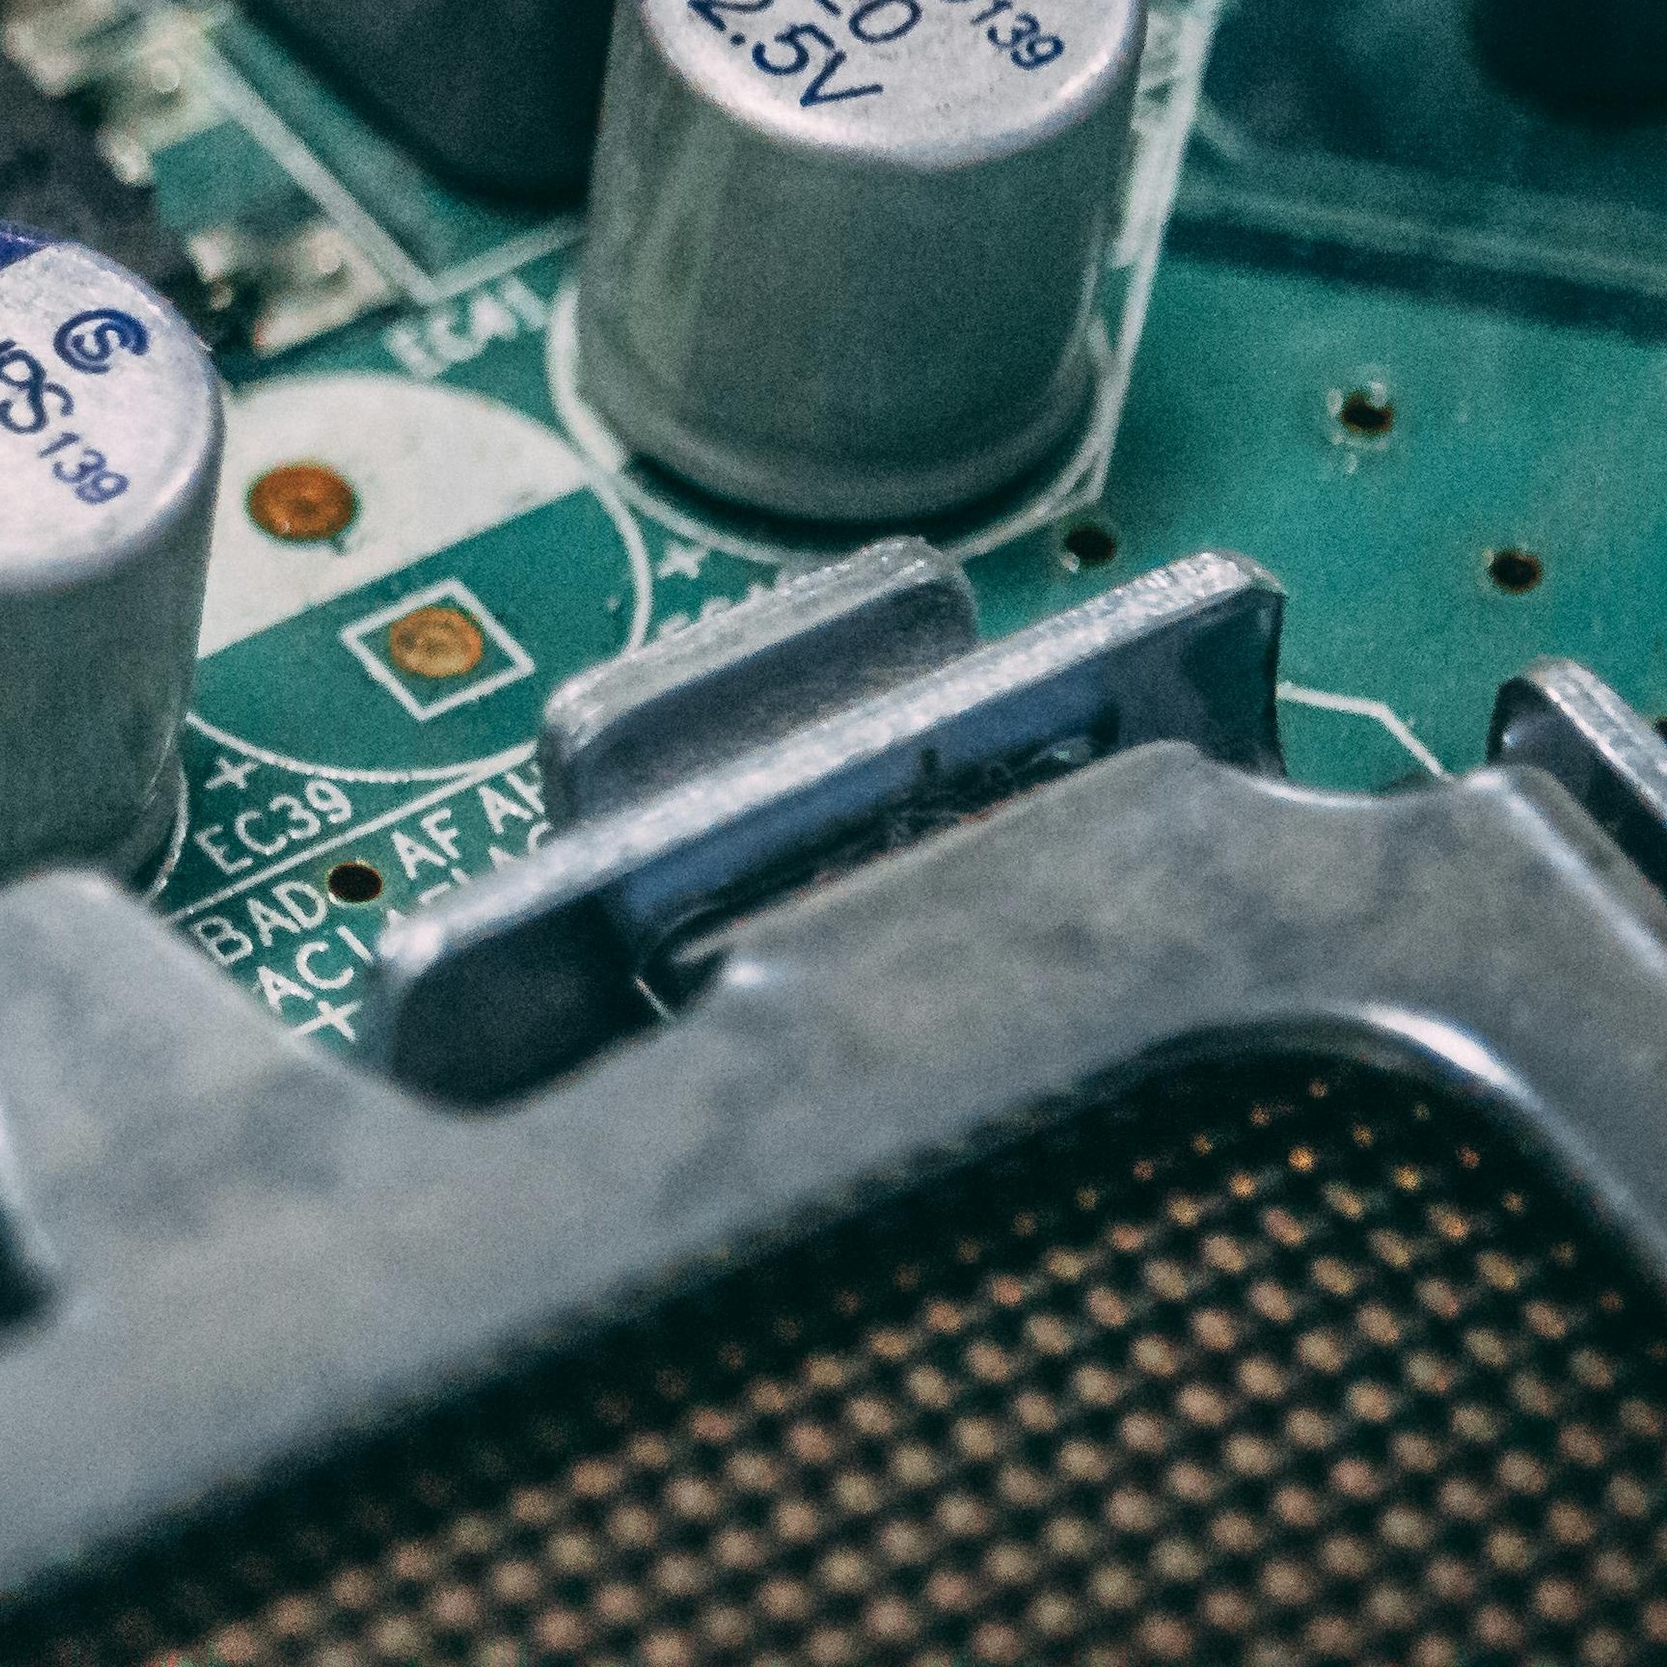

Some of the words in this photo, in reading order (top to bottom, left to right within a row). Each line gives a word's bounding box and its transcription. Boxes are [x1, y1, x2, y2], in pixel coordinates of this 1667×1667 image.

[38, 431, 131, 506] 139
[193, 779, 353, 876] EC39
[389, 808, 460, 880] AF
